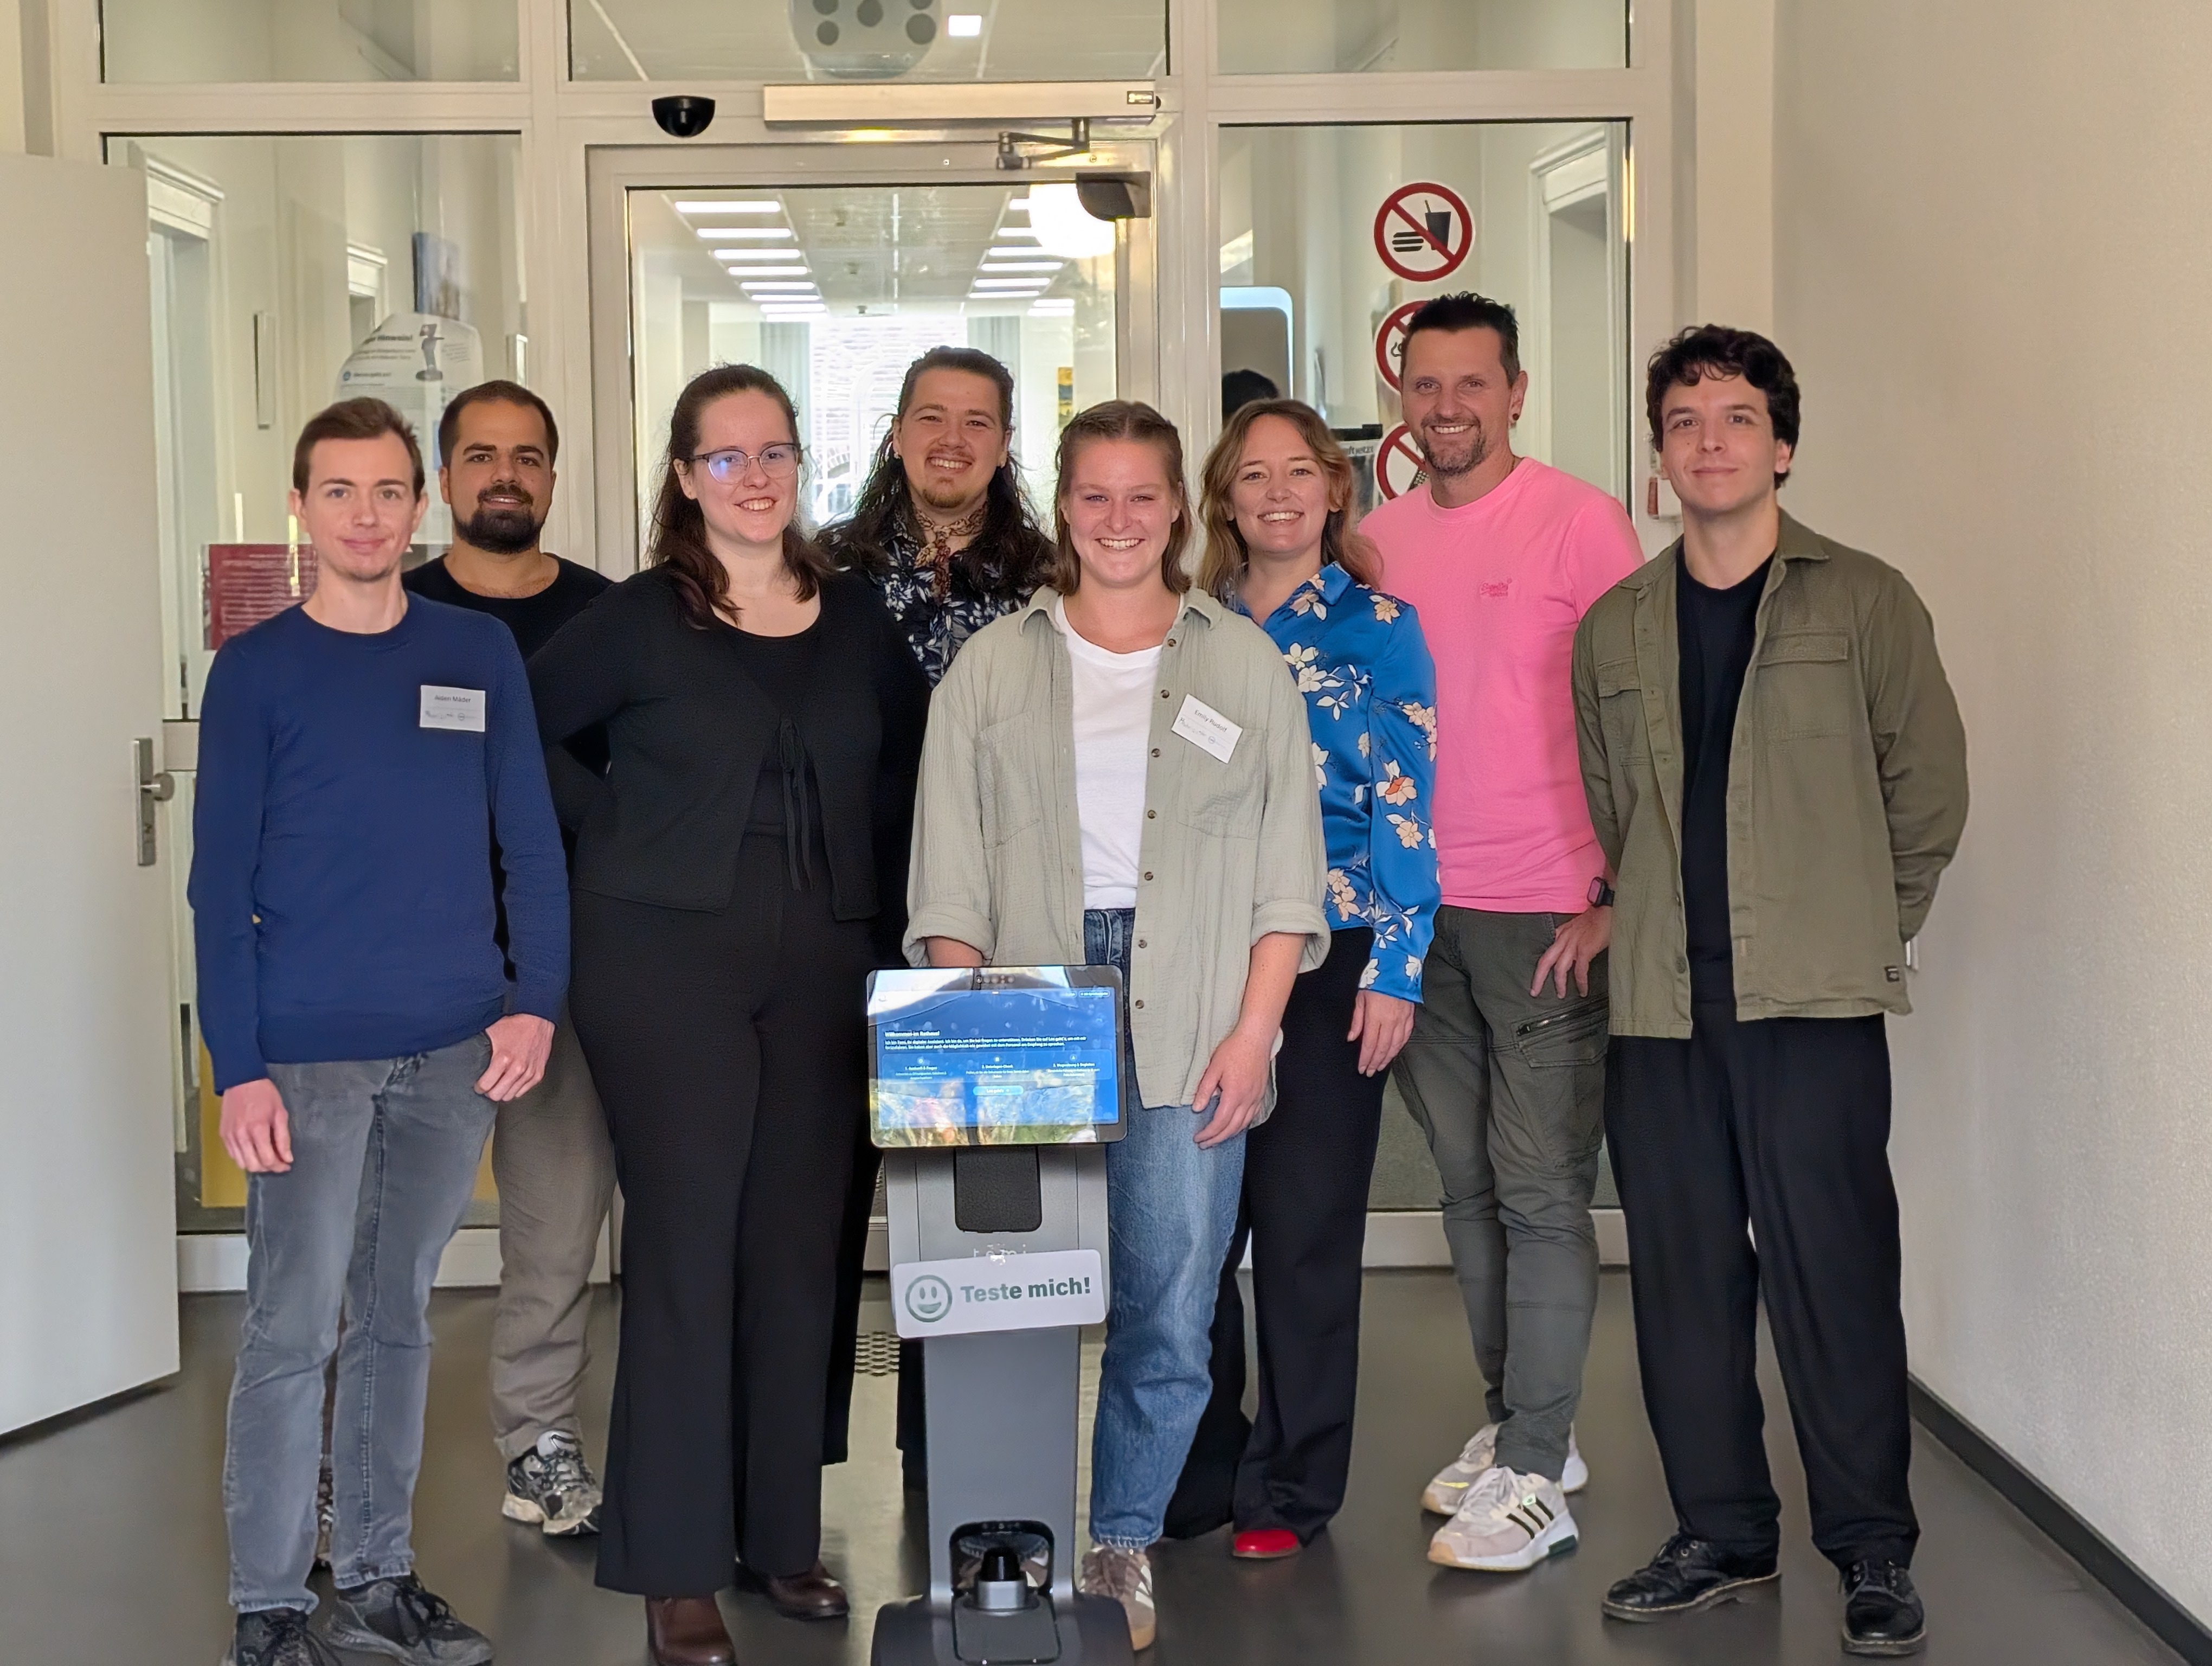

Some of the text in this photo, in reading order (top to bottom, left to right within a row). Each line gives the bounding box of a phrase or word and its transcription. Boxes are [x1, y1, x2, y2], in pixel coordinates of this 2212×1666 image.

[1194, 709, 1210, 722] Emily
[1210, 717, 1227, 732] Rudolf
[960, 1277, 1090, 1303] Teste mich!
